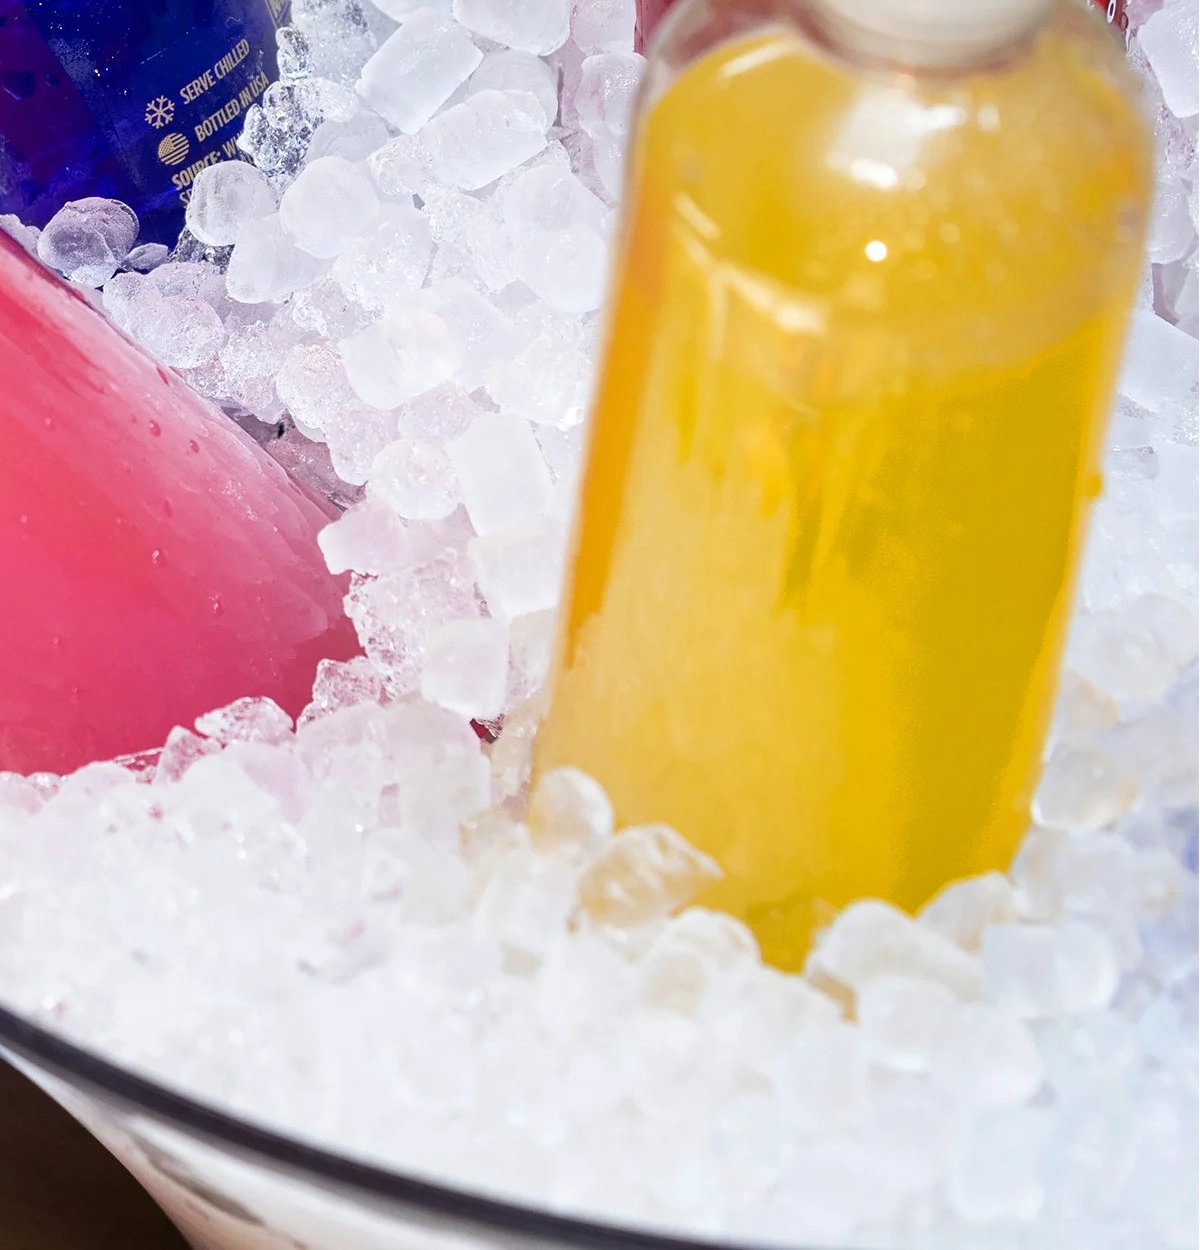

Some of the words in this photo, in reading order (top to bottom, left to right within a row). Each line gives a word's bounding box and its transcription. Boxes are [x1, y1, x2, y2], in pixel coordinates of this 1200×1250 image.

[179, 68, 216, 106] SERVE
[213, 38, 251, 80] CHILLED
[193, 101, 241, 143] BOTTLED
[240, 91, 253, 109] IN
[250, 71, 270, 101] USA
